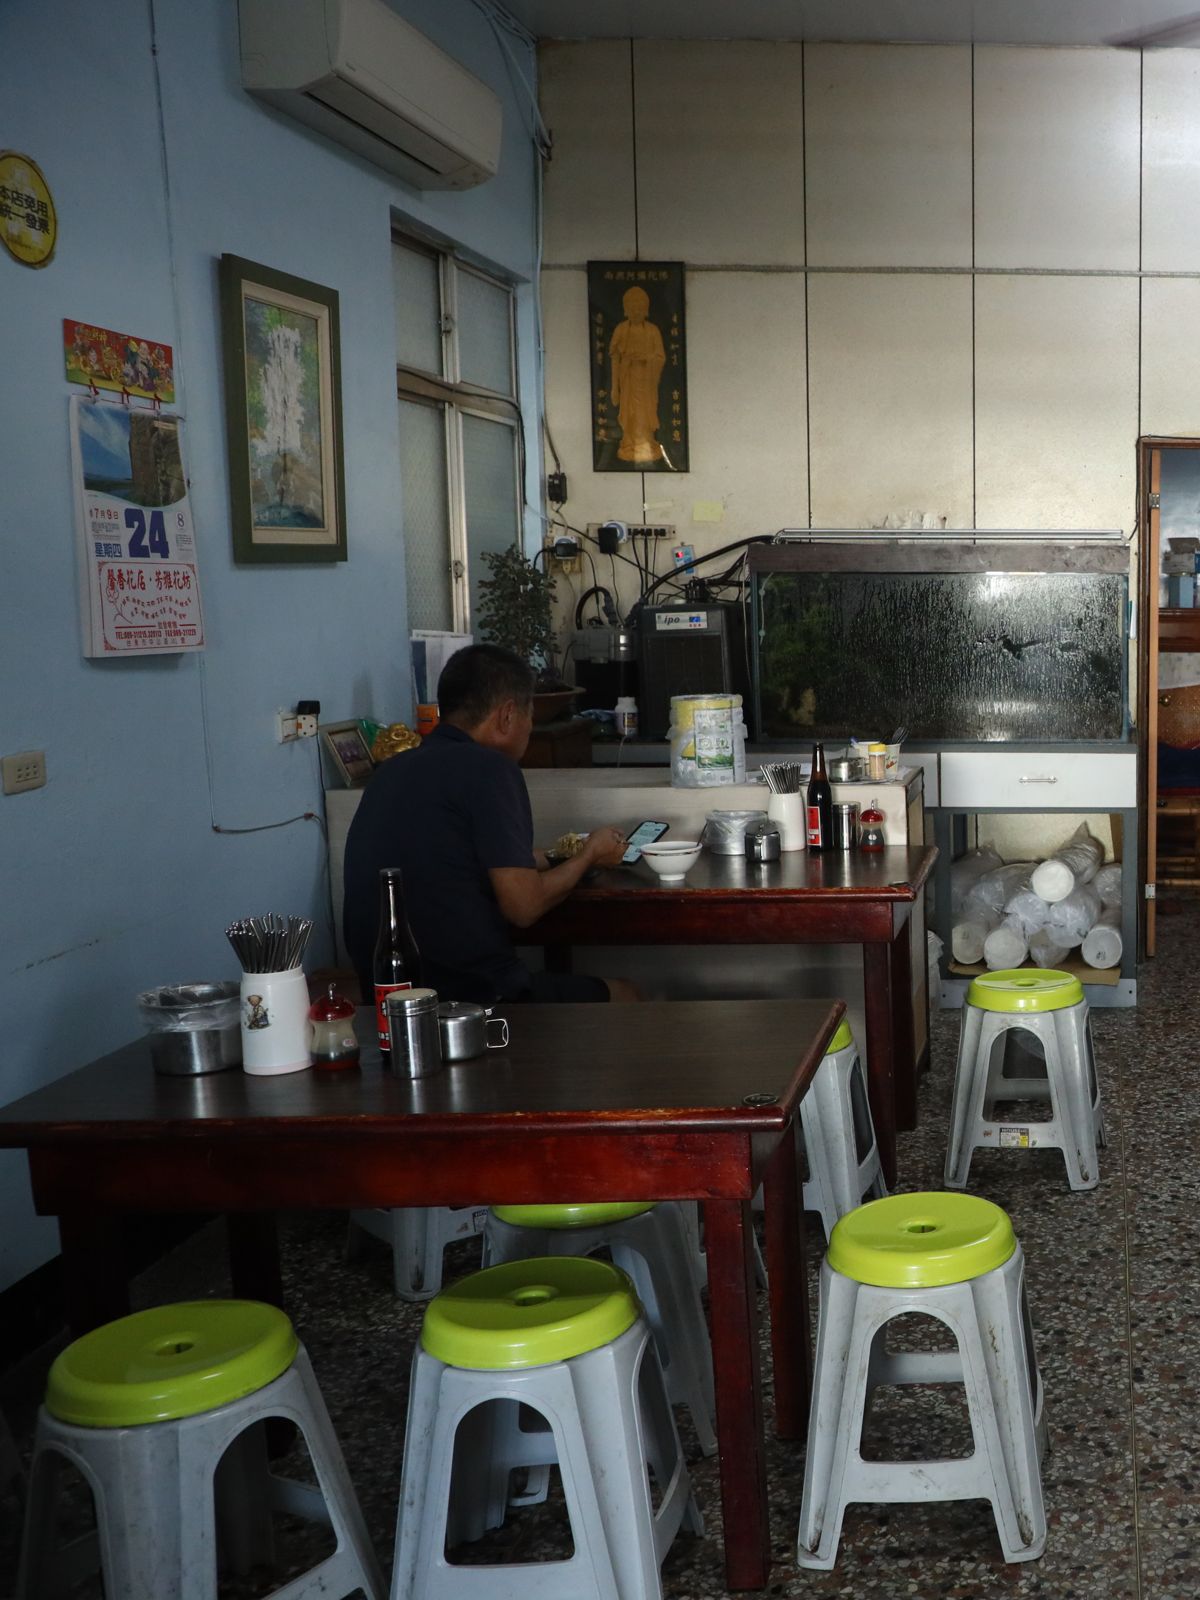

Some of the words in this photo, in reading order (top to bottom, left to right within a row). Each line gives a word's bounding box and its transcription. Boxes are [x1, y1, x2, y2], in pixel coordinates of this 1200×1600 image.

[124, 508, 169, 558] 24
[95, 542, 122, 558] 星期四
